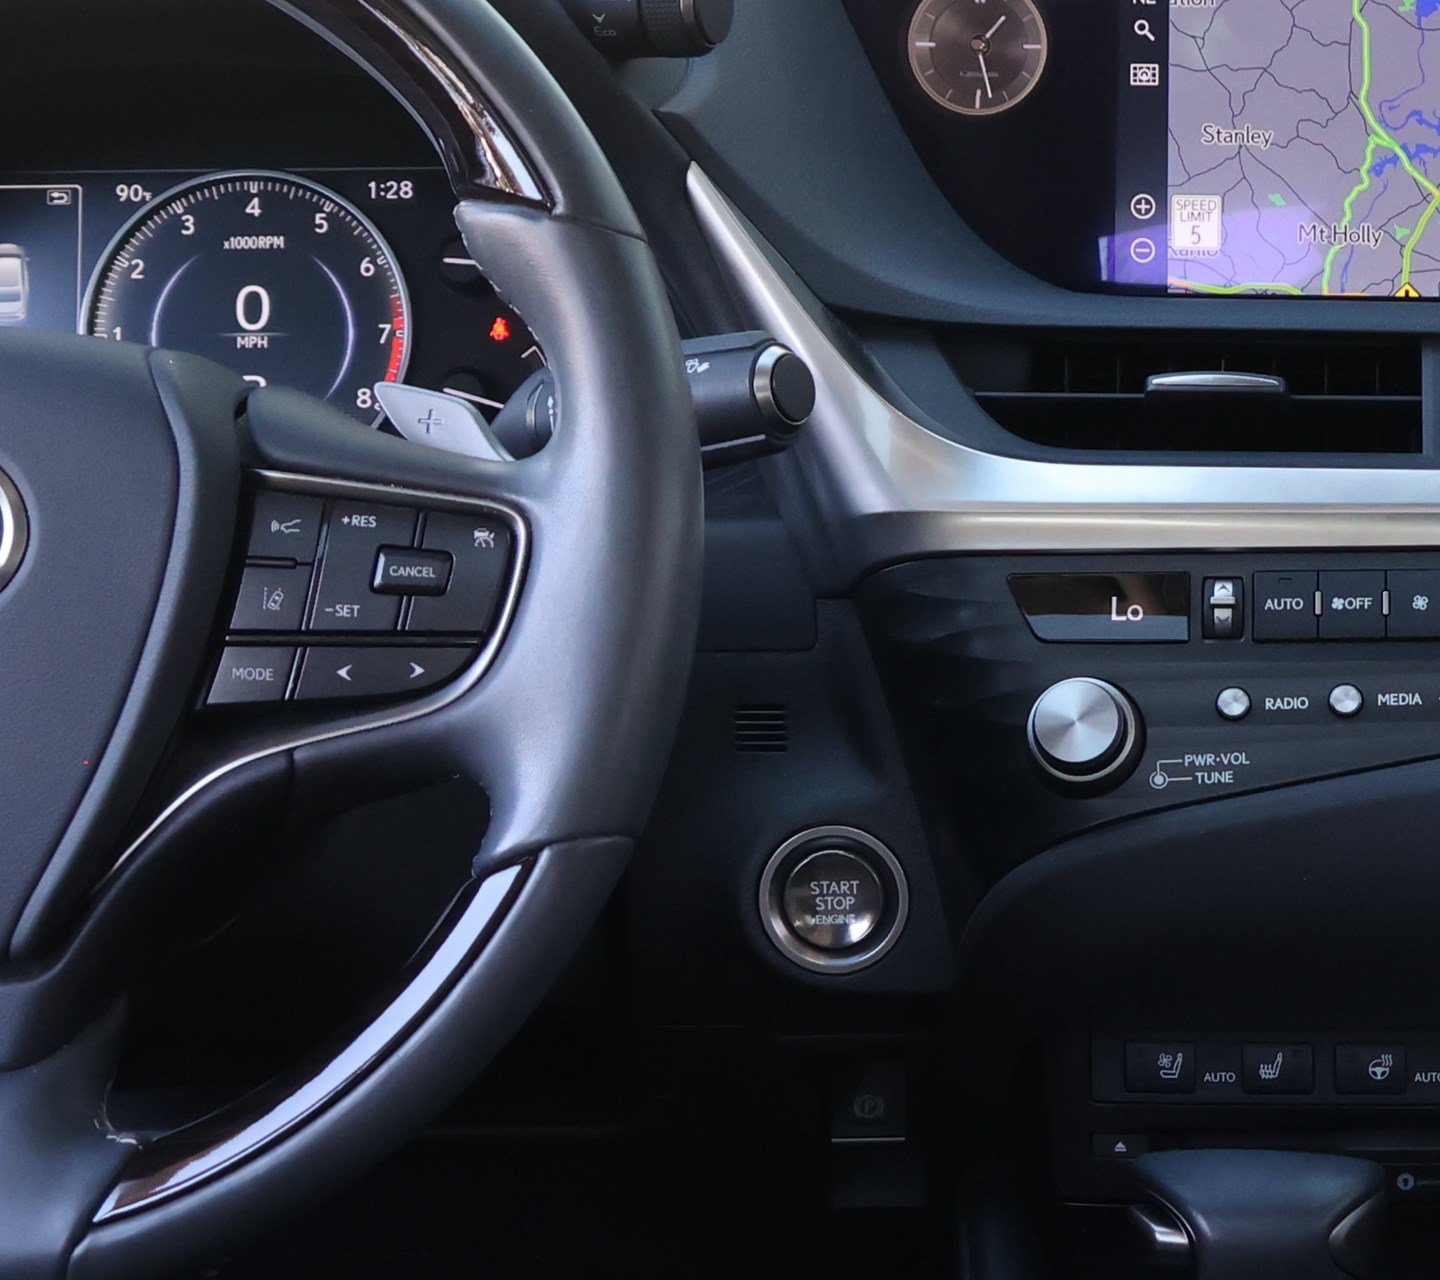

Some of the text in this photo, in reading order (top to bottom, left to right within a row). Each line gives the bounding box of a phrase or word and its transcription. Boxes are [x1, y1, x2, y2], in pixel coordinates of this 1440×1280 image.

[593, 26, 617, 37] Eco
[1202, 125, 1273, 148] Stanley
[367, 180, 414, 199] 1:28
[245, 197, 262, 217] 4
[1176, 199, 1217, 212] SPEED
[313, 213, 329, 234] 5
[1179, 211, 1212, 223] LIMIT
[180, 214, 196, 236] 3
[1190, 225, 1201, 245] 5
[1298, 225, 1384, 246] Mt Holly
[223, 236, 285, 251] x1000RPM
[130, 259, 146, 279] 2
[359, 256, 376, 277] 6
[235, 284, 271, 331] 0
[112, 326, 122, 341] 1
[378, 323, 392, 344] 7
[236, 335, 269, 349] MPH
[356, 387, 372, 409] 8
[389, 565, 436, 578] CANCEL
[1111, 596, 1144, 621] Lo
[1264, 598, 1304, 611] AUTO
[1344, 597, 1373, 610] OFF
[231, 667, 274, 682] MODE
[1265, 697, 1309, 711] RADIO
[1377, 693, 1423, 707] MEDIA
[1195, 772, 1234, 785] TUNE
[810, 880, 860, 895] START
[815, 896, 856, 911] STOP
[815, 913, 857, 925] ENGINE
[1203, 1071, 1236, 1083] AUTO
